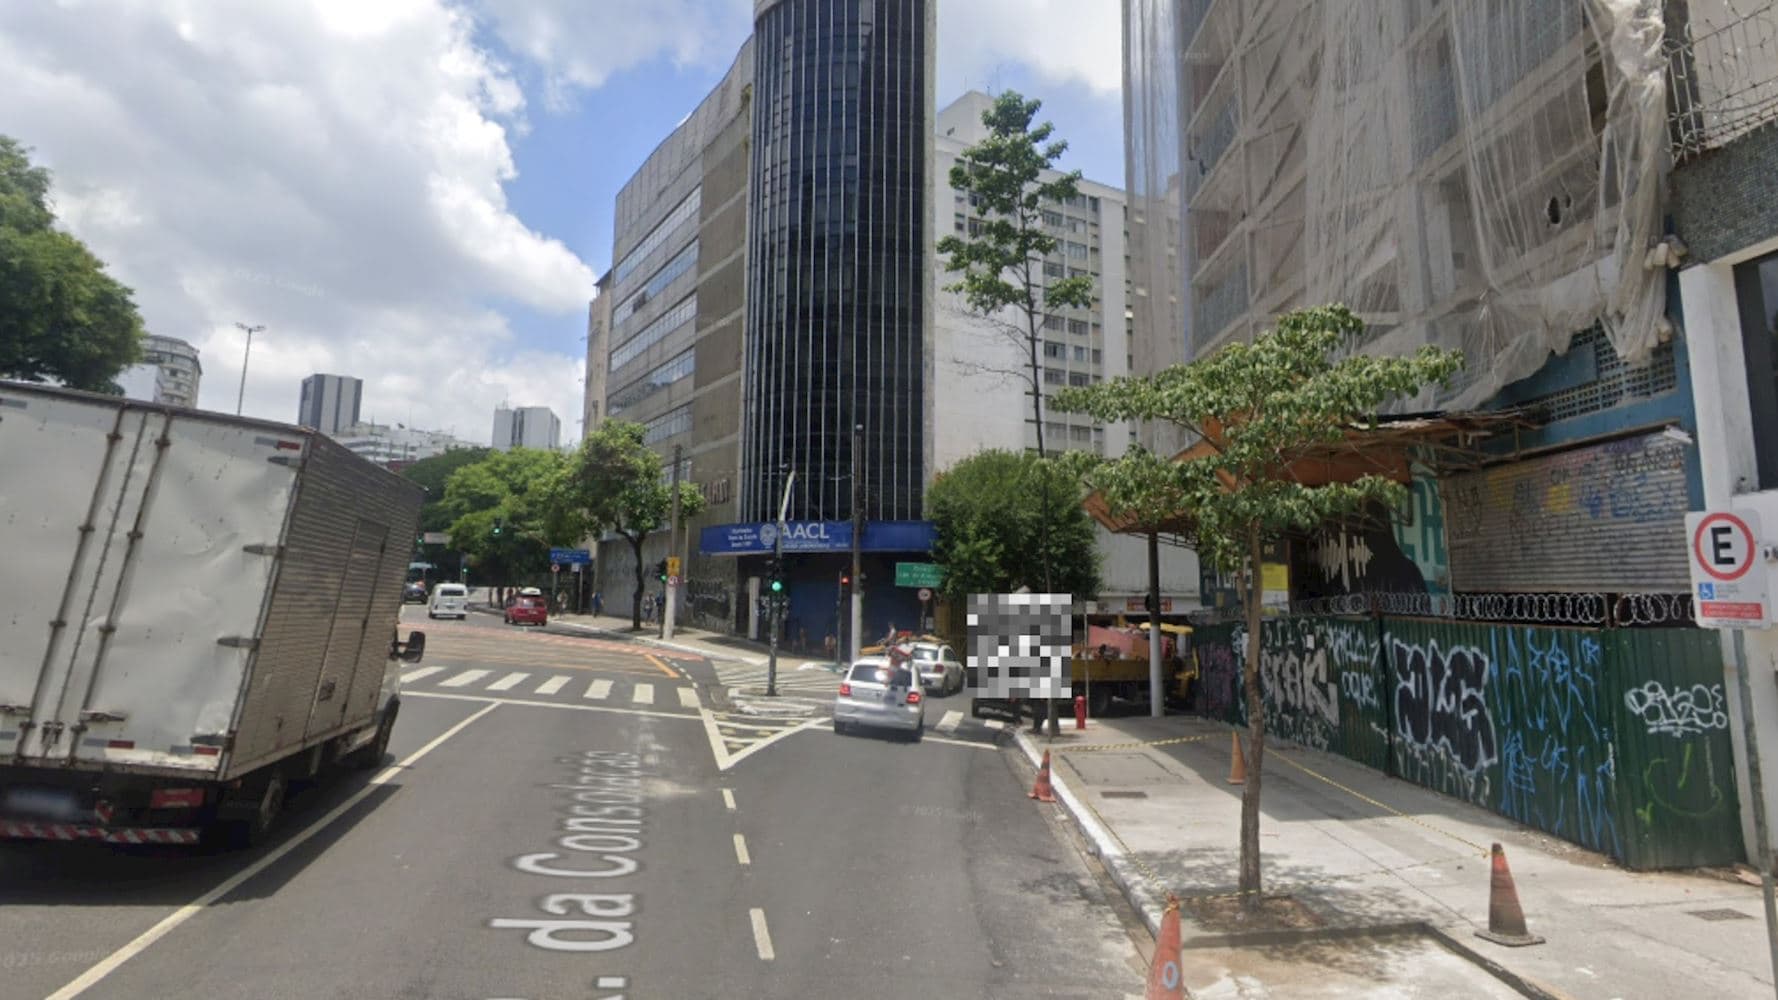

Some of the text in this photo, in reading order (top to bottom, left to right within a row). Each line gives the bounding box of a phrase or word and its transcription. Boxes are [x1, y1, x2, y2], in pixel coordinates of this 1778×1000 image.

[782, 522, 830, 539] AACL
[1711, 527, 1736, 565] E
[490, 893, 634, 951] da
